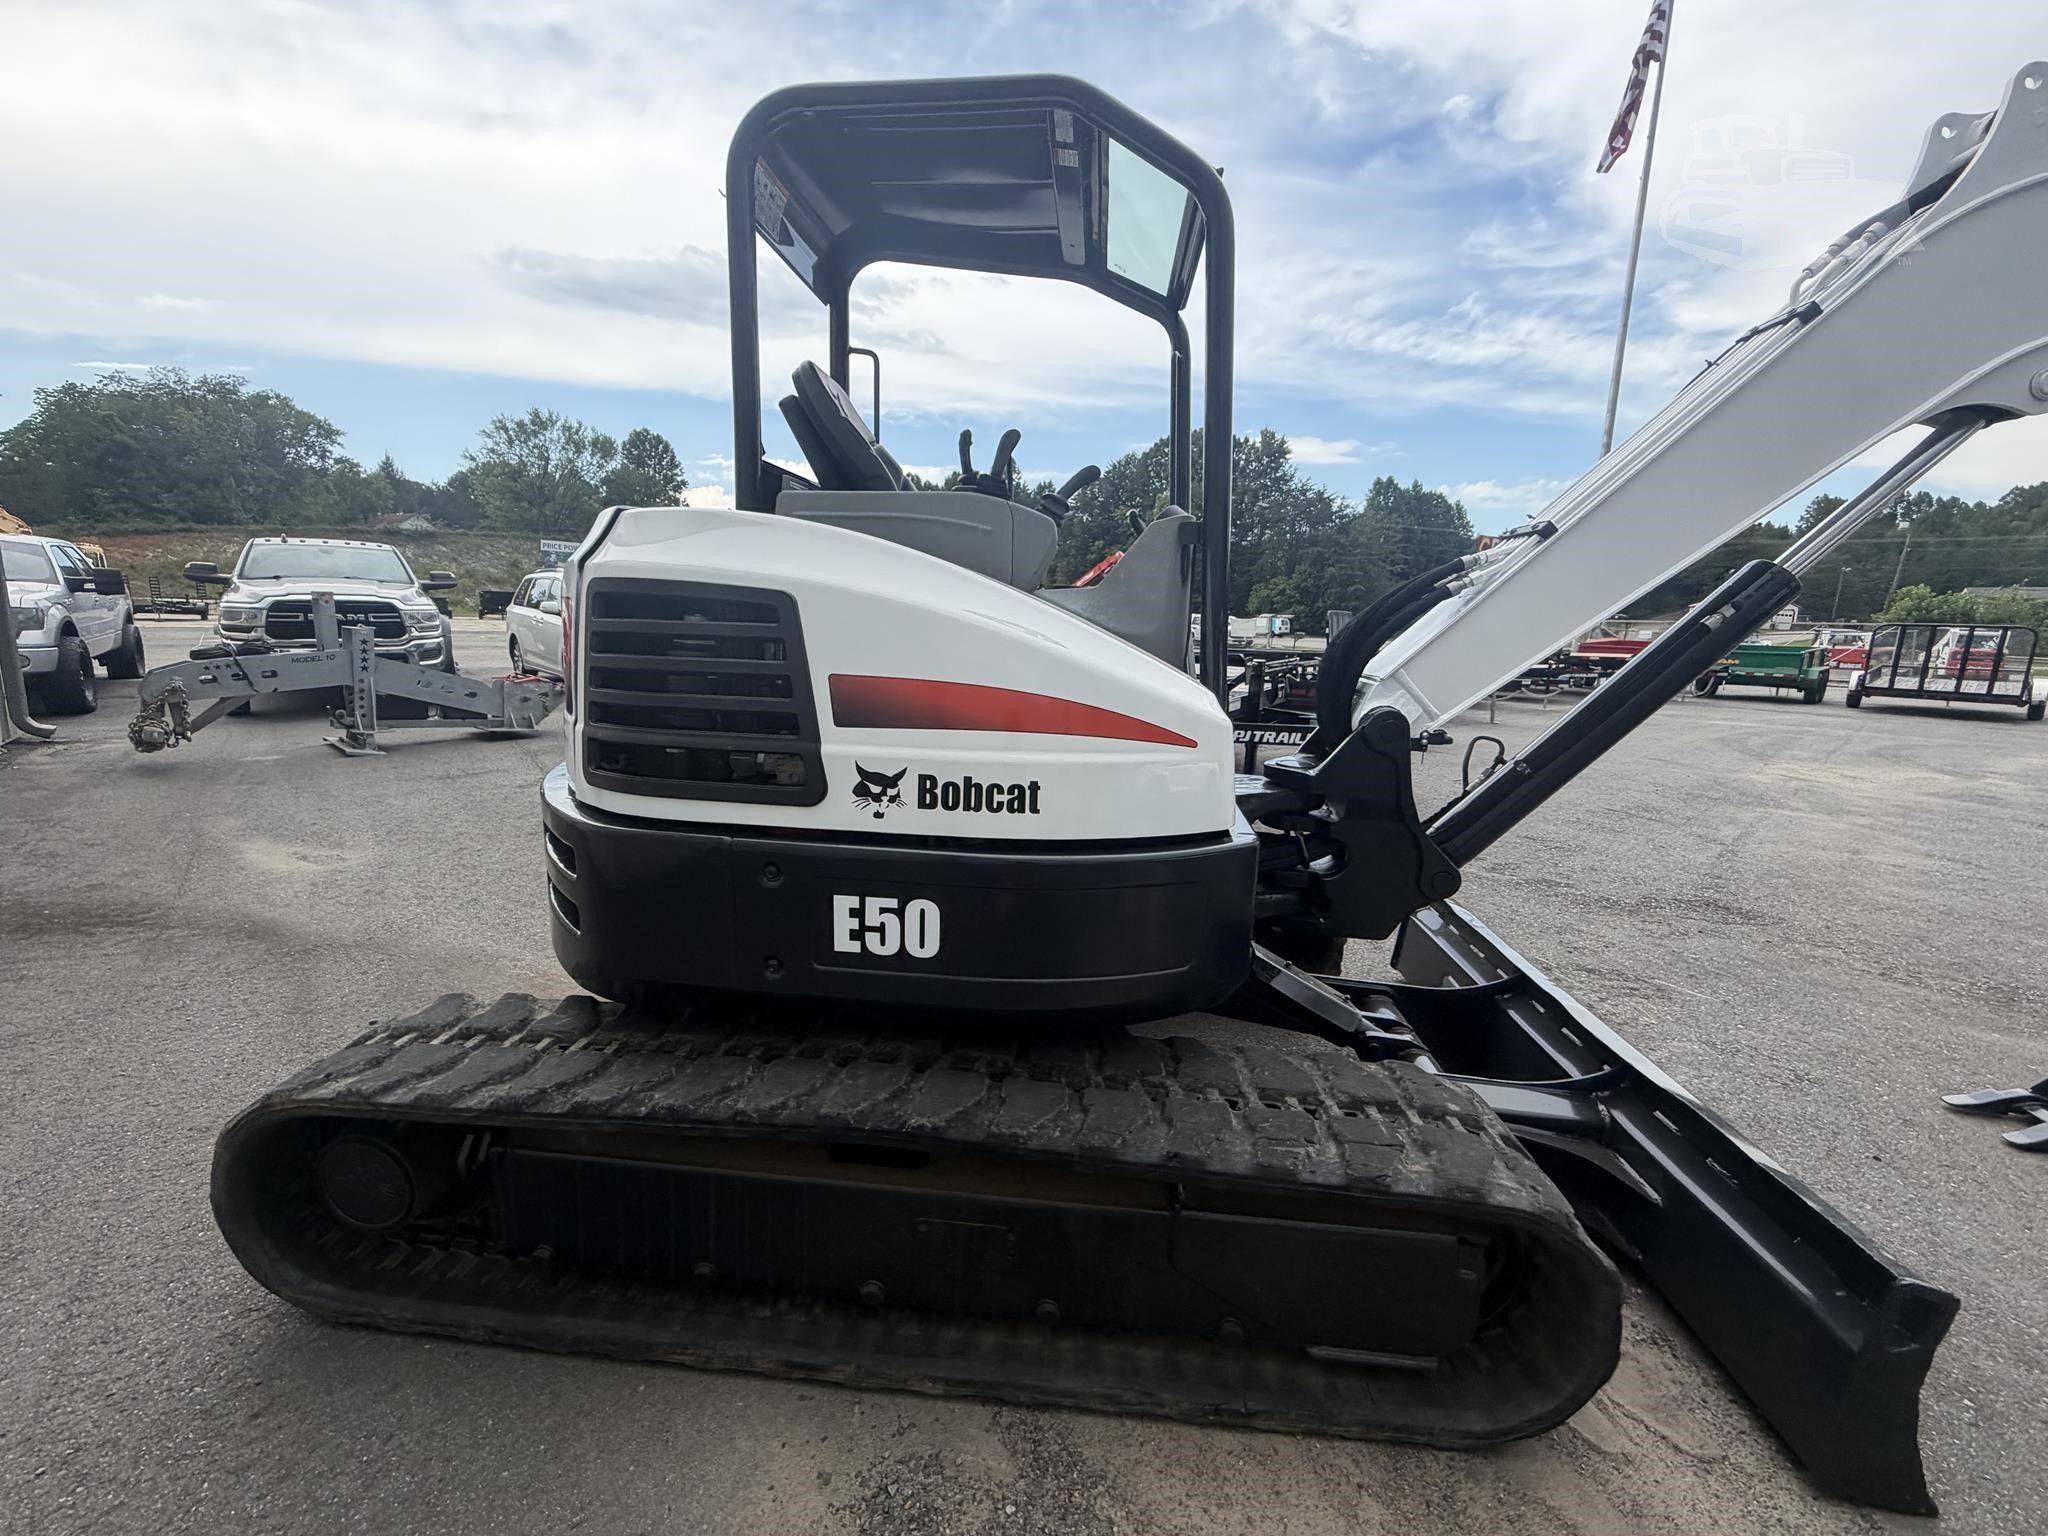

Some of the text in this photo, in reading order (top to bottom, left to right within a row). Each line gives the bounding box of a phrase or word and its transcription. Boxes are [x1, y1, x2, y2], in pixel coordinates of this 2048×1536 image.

[542, 542, 562, 550] PRICE
[290, 655, 323, 664] MODEL
[917, 773, 1040, 814] Bobcat
[833, 894, 941, 959] E50
